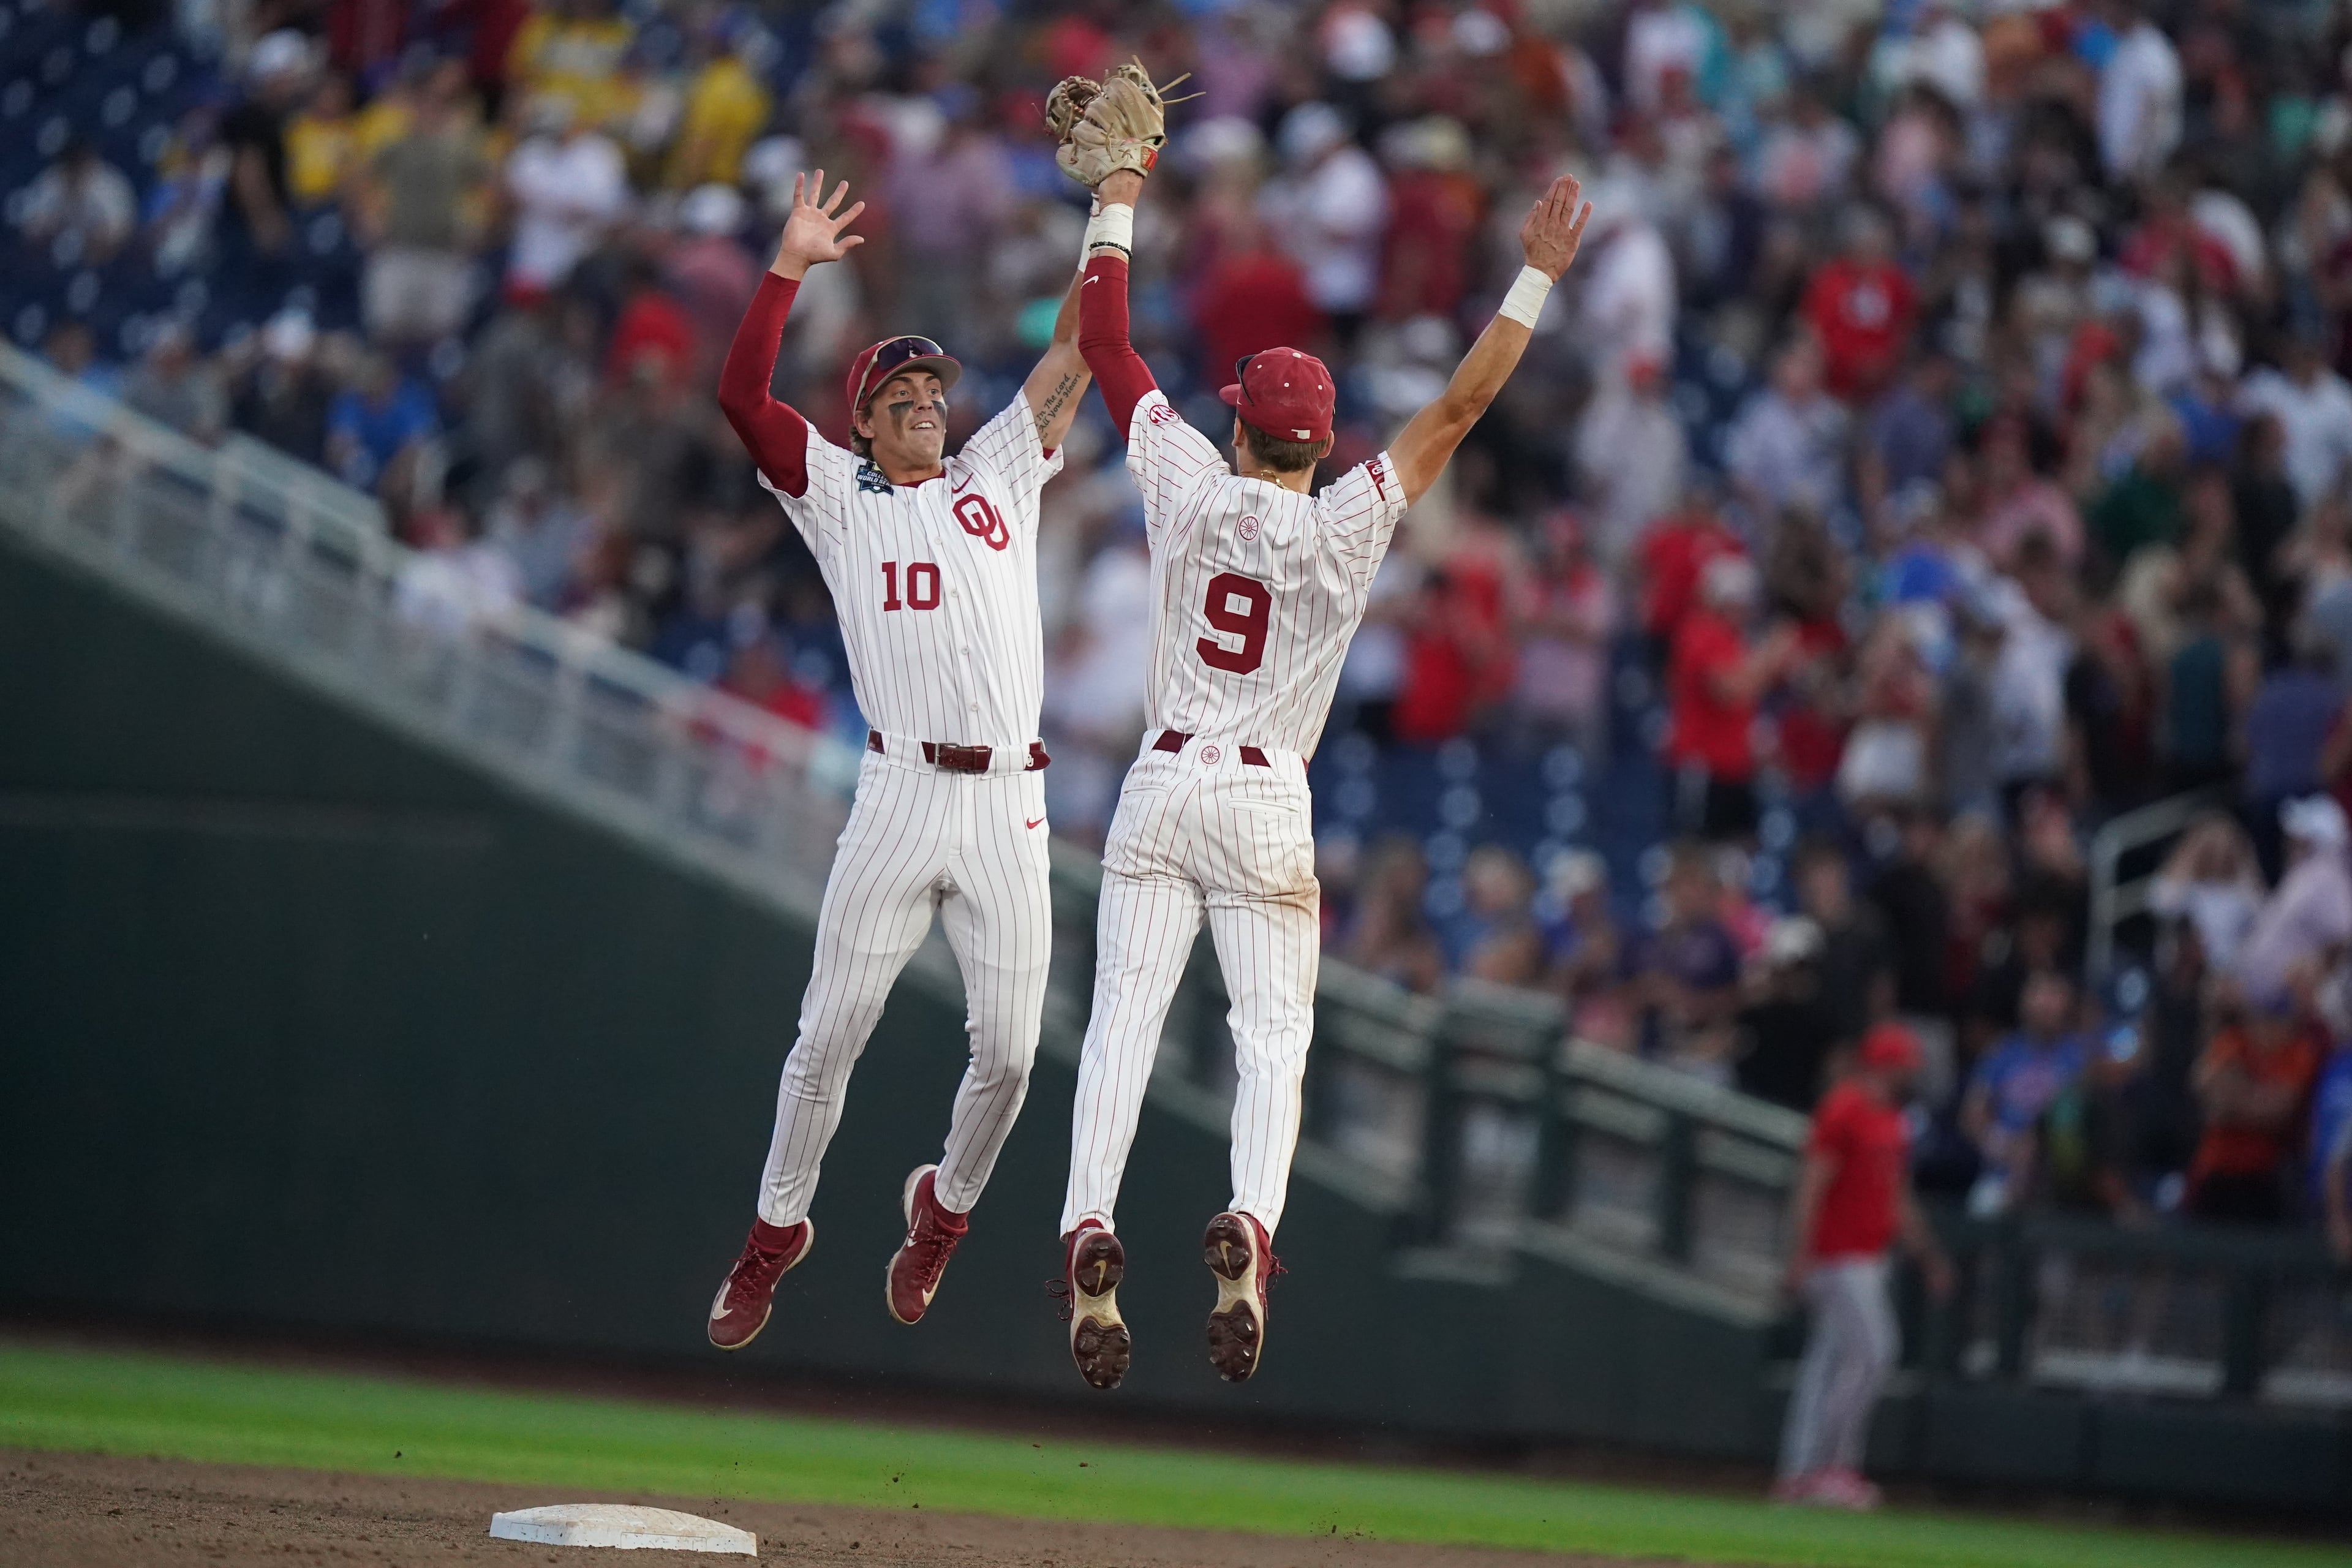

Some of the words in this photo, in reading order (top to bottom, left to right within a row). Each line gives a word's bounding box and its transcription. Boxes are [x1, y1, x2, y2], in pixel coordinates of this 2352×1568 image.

[1036, 411, 1046, 420] In
[1044, 395, 1057, 409] The
[1055, 372, 1070, 395] Lord
[1039, 416, 1050, 432] All
[1047, 398, 1063, 418] Your
[1063, 374, 1081, 398] Heart
[857, 474, 879, 483] WORLD
[952, 493, 1010, 551] OU
[881, 561, 941, 612] 10
[1196, 571, 1273, 676] 9
